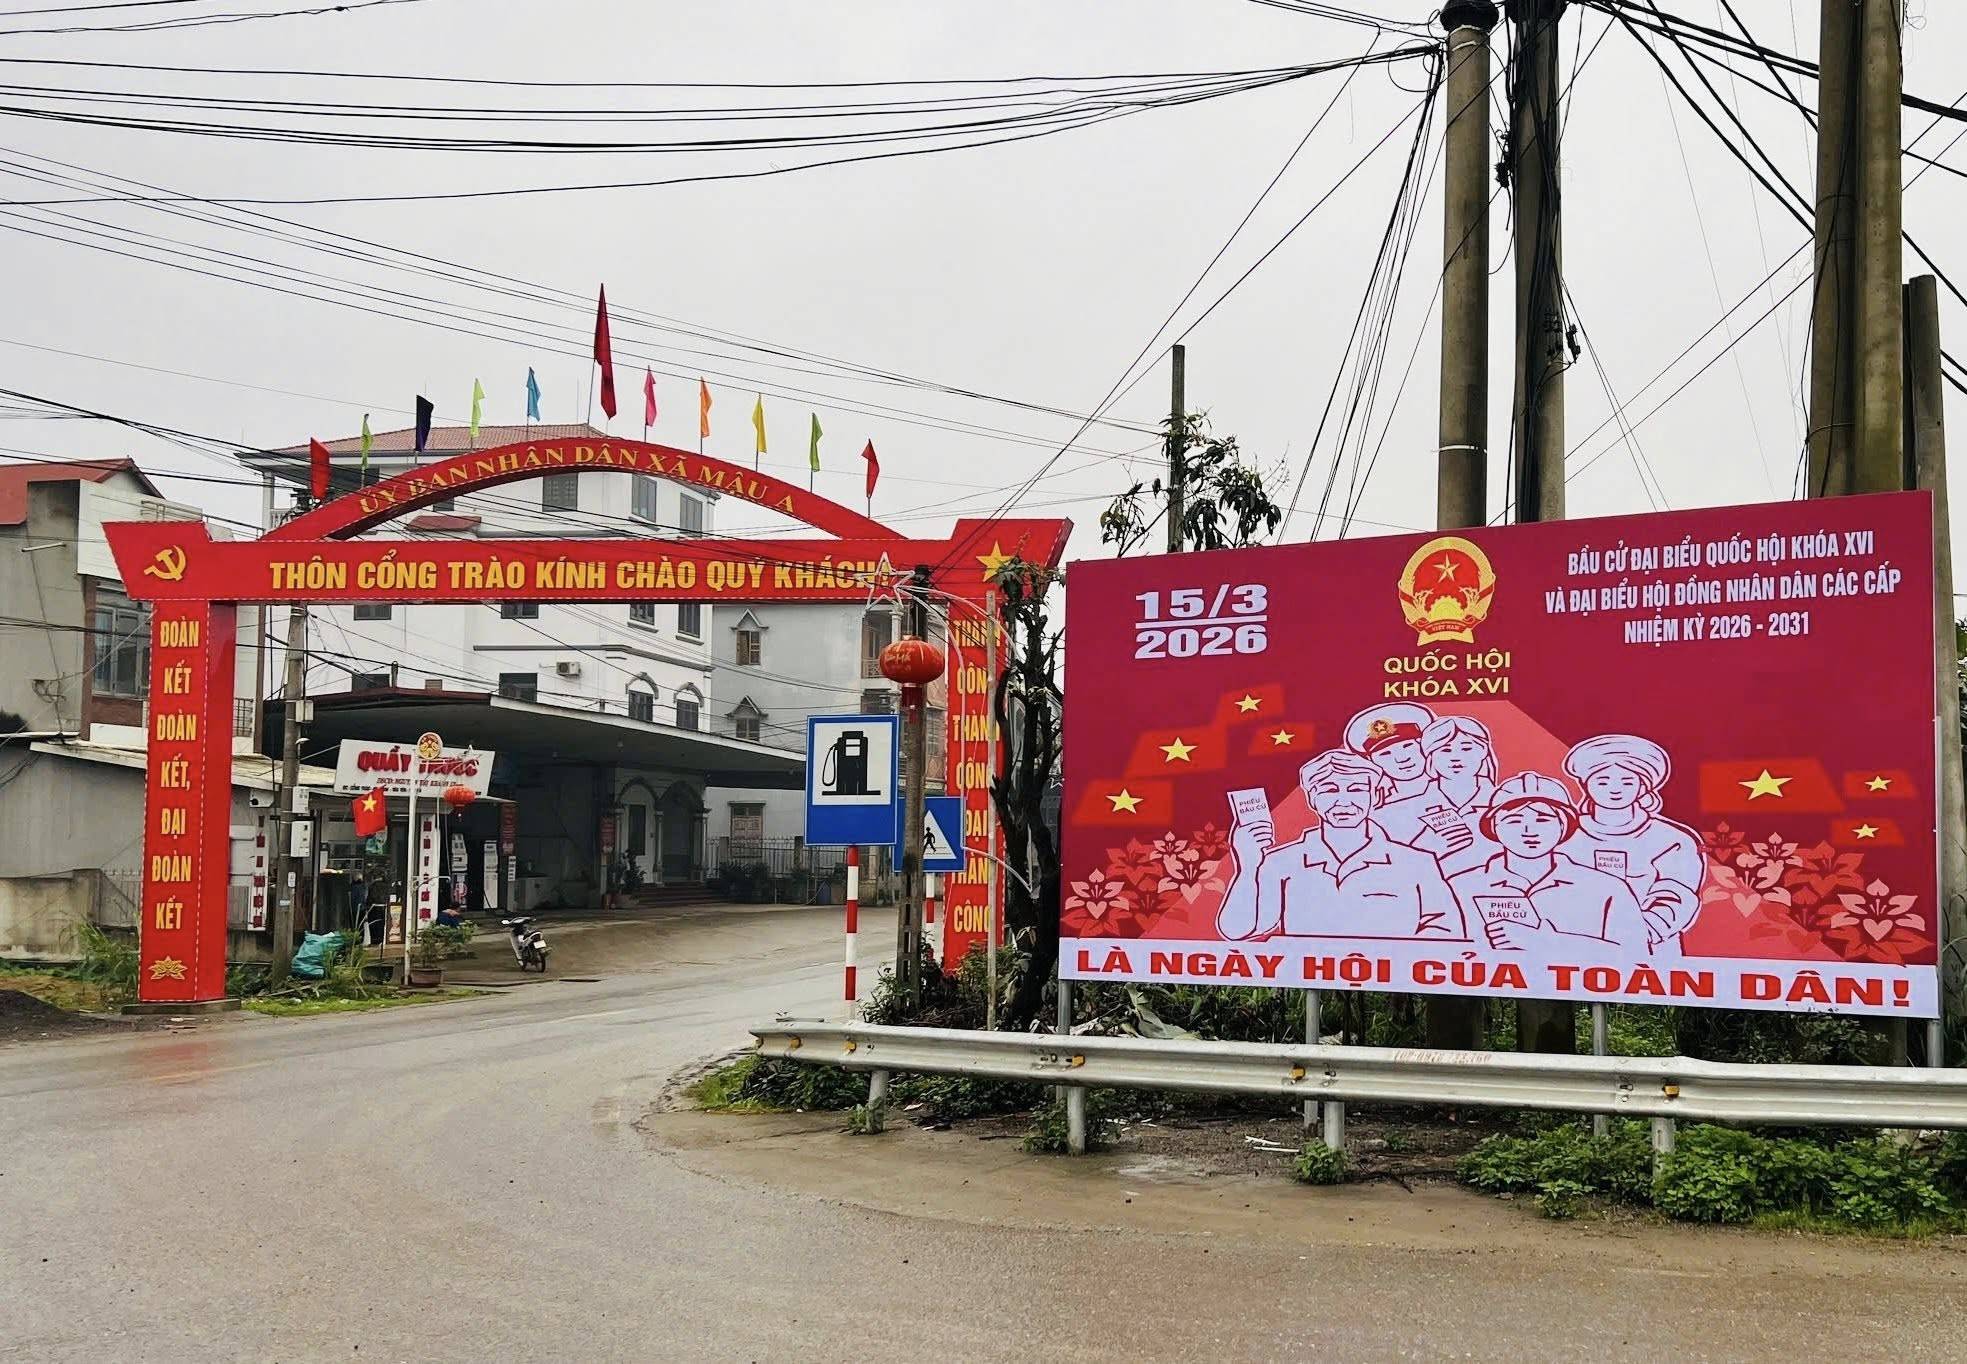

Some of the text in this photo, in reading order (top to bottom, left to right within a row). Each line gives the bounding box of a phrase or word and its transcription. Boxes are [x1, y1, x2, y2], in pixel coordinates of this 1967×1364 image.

[409, 462, 469, 496] BAN
[475, 446, 565, 477] NHÂN
[574, 442, 640, 467] DÂN
[647, 452, 689, 479] XÃ
[697, 464, 769, 500] MẬU
[774, 494, 795, 513] A
[269, 555, 347, 589] THÔN
[357, 548, 438, 589] CỔNG
[448, 556, 525, 589] TRÀO
[535, 556, 606, 589] KÍNH
[616, 555, 696, 589] CHÀO
[1567, 528, 1874, 576] BẦU CỬ ĐẠI BIỂU QUỐC HỘI KHÓA XVI
[1135, 583, 1268, 620] 15/3
[1545, 560, 1902, 617] VÀ ĐẠI BIỂU HỘI ĐỒNG NHÂN DÂN CÁC CẤP
[160, 615, 200, 648] ĐOÀN
[1134, 624, 1268, 660] 2026
[1624, 615, 1679, 647] NHIỆM
[1683, 612, 1706, 641] KỲ
[1709, 614, 1752, 640] 2026
[1768, 611, 1810, 637] 2031
[163, 659, 192, 694] KẾT
[1383, 647, 1511, 674] QUỐC HỘI
[1384, 675, 1510, 698] KHÓA XVI
[156, 709, 197, 741] ĐOÀN
[160, 752, 190, 791] KẾT,
[160, 807, 187, 840] ĐẠI
[152, 850, 192, 882] ĐOÀN
[155, 895, 184, 930] KẾT
[1077, 945, 1910, 1008] LÀ NGÀY HỘI CỦA TOÀN DÂN!
